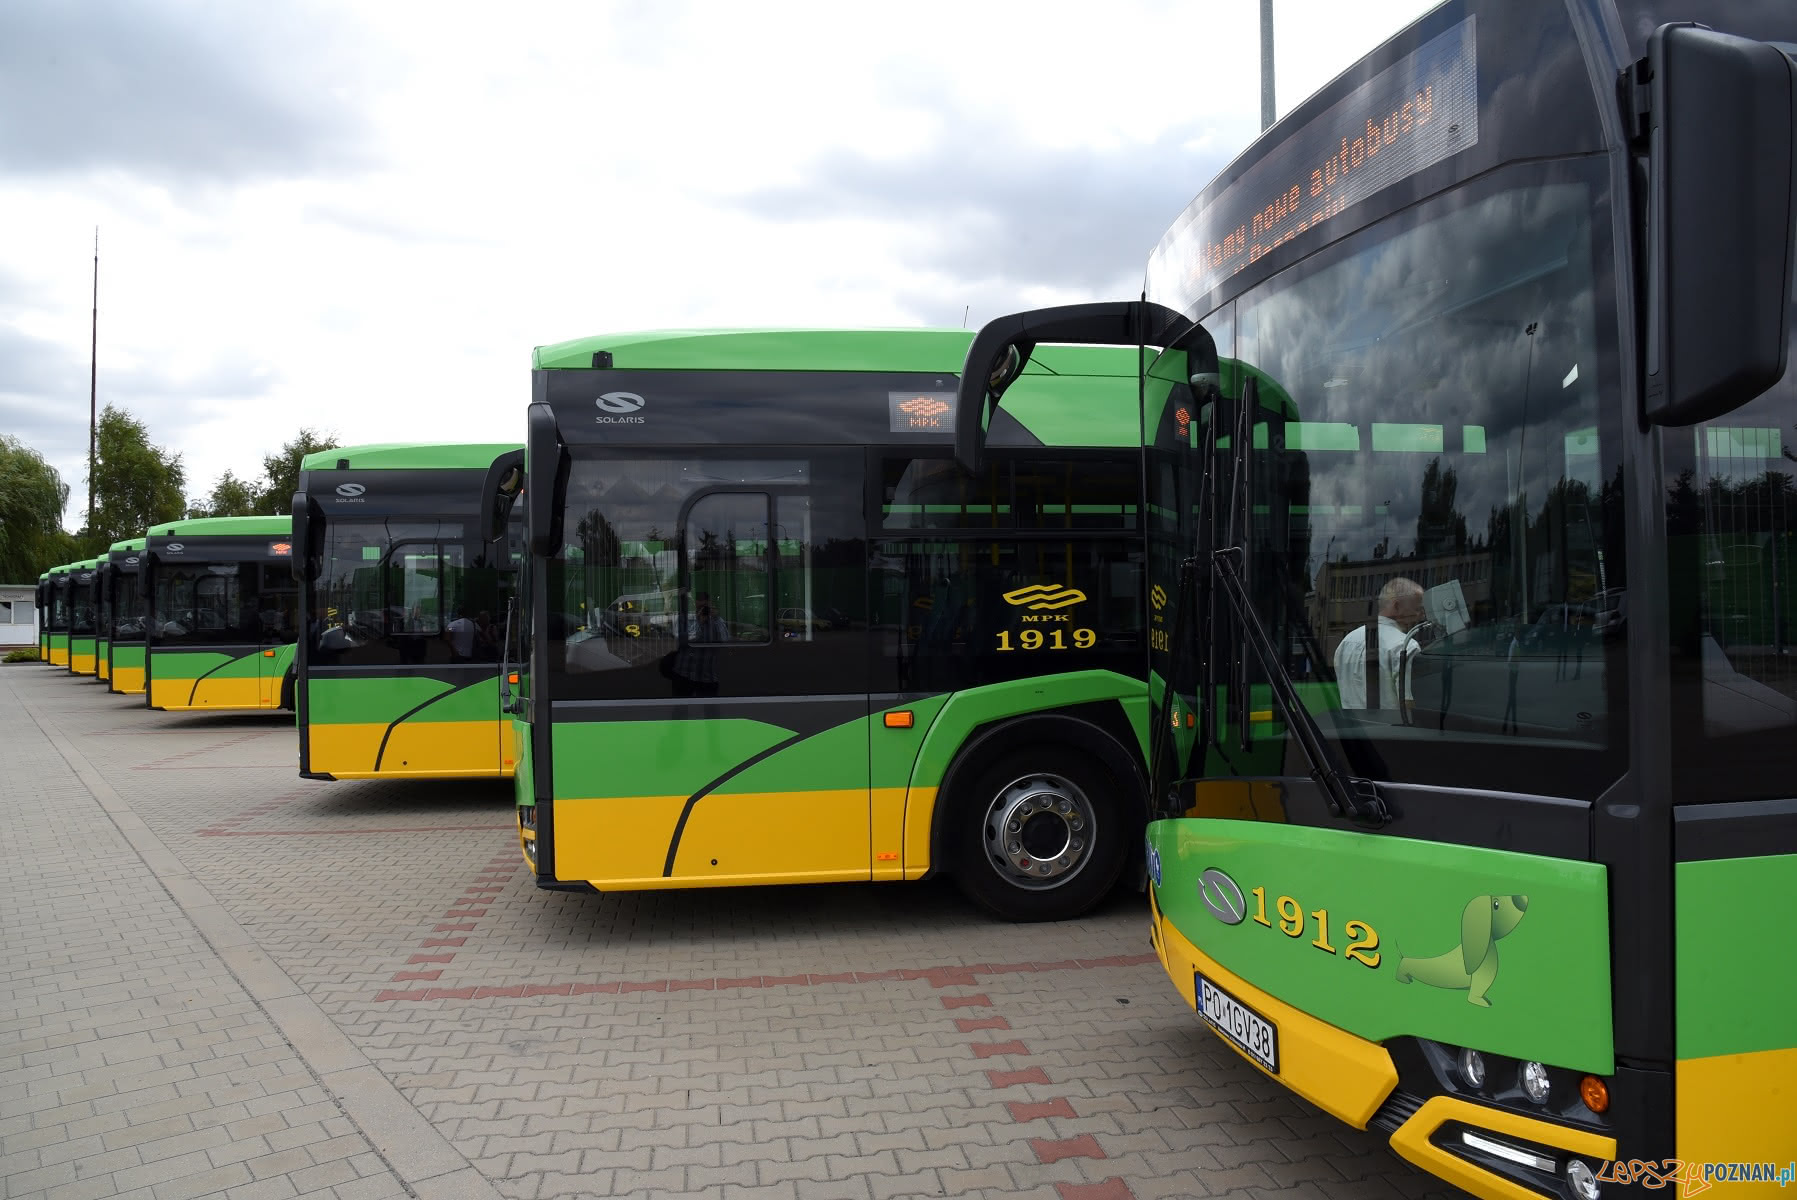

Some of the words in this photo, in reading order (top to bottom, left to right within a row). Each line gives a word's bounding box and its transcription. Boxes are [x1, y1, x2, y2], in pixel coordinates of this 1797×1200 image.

[1252, 184, 1300, 239] nowe
[1310, 86, 1432, 198] autobusy
[595, 416, 645, 424] SOLARIS
[909, 417, 940, 427] MPK
[1021, 614, 1070, 622] MPK
[996, 628, 1097, 651] 1919
[1252, 886, 1381, 969] 1912
[1203, 983, 1221, 1020] PO
[1226, 1000, 1270, 1058] 1GV38
